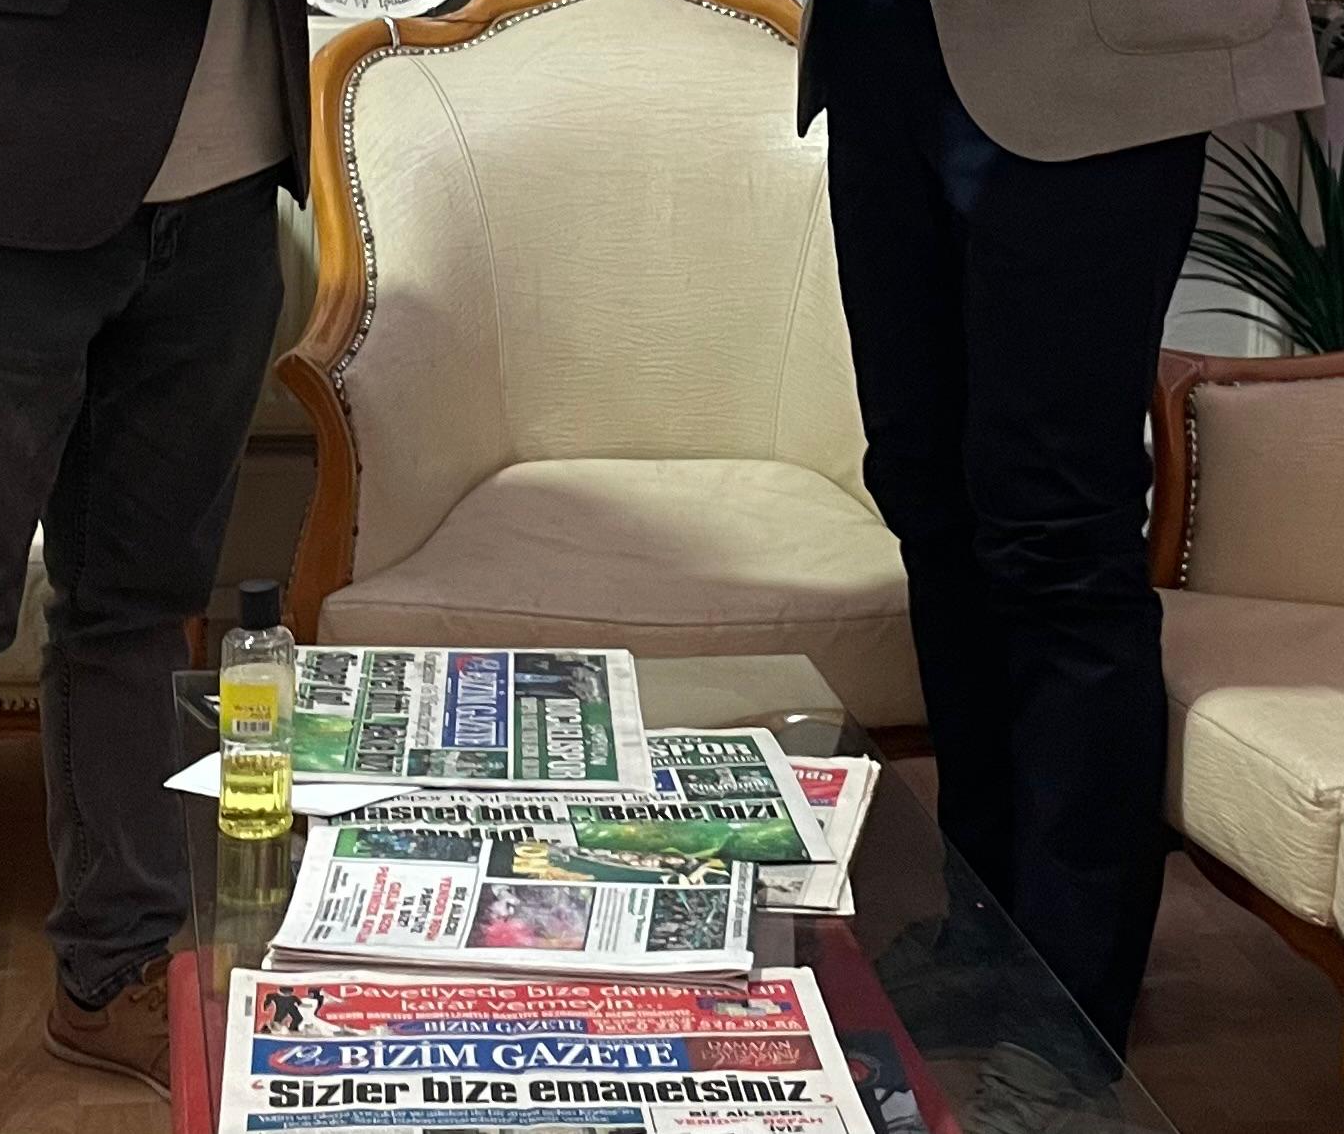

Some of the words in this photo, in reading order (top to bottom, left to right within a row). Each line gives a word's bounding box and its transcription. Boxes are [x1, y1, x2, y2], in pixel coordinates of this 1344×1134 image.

[599, 803, 706, 821] Bekle
[339, 984, 518, 1003] Davetiyede
[527, 984, 591, 998] bize
[401, 999, 476, 1012] karar
[338, 1040, 479, 1069] BİZİM
[491, 1039, 679, 1069] GAZETE
[268, 1077, 411, 1108] Sizler
[422, 1075, 518, 1105] bize
[528, 1073, 813, 1104] emanetsiniz
